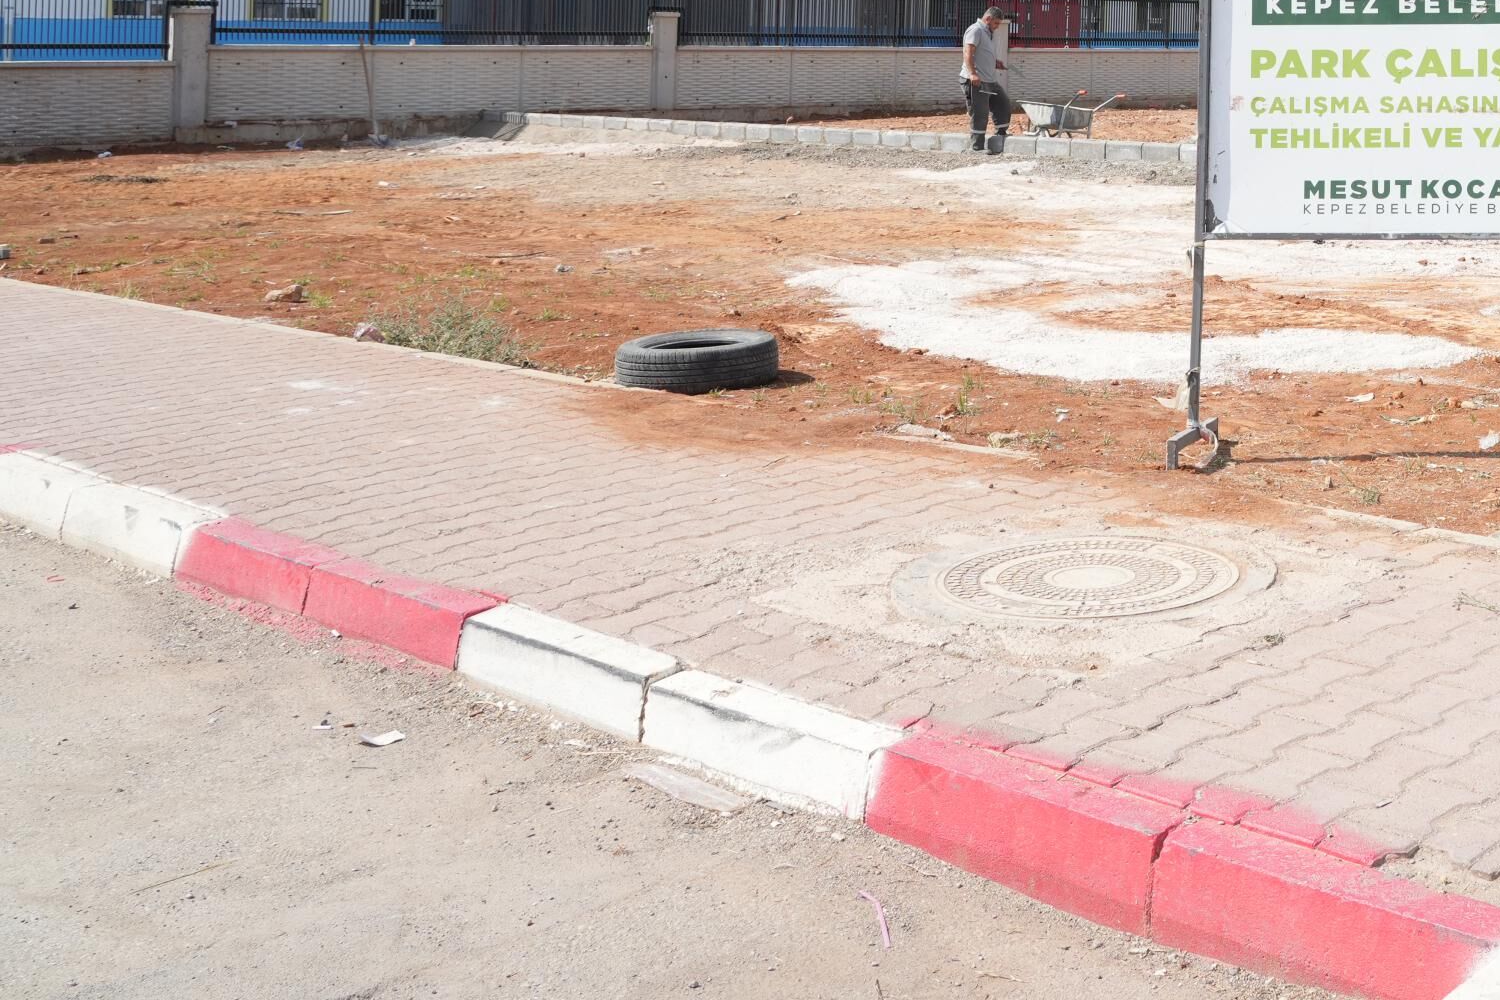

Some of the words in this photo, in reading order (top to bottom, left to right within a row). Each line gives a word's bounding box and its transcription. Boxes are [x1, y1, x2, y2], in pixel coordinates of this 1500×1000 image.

[1251, 49, 1370, 78] PARK
[1251, 96, 1368, 117] ÇALIŞMA
[1250, 122, 1411, 148] TEHLİKELİ
[1421, 128, 1463, 148] VE
[1304, 179, 1412, 199] MESUT
[1304, 203, 1367, 215] KEPEZ
[1376, 200, 1478, 215] BELEDİYE
